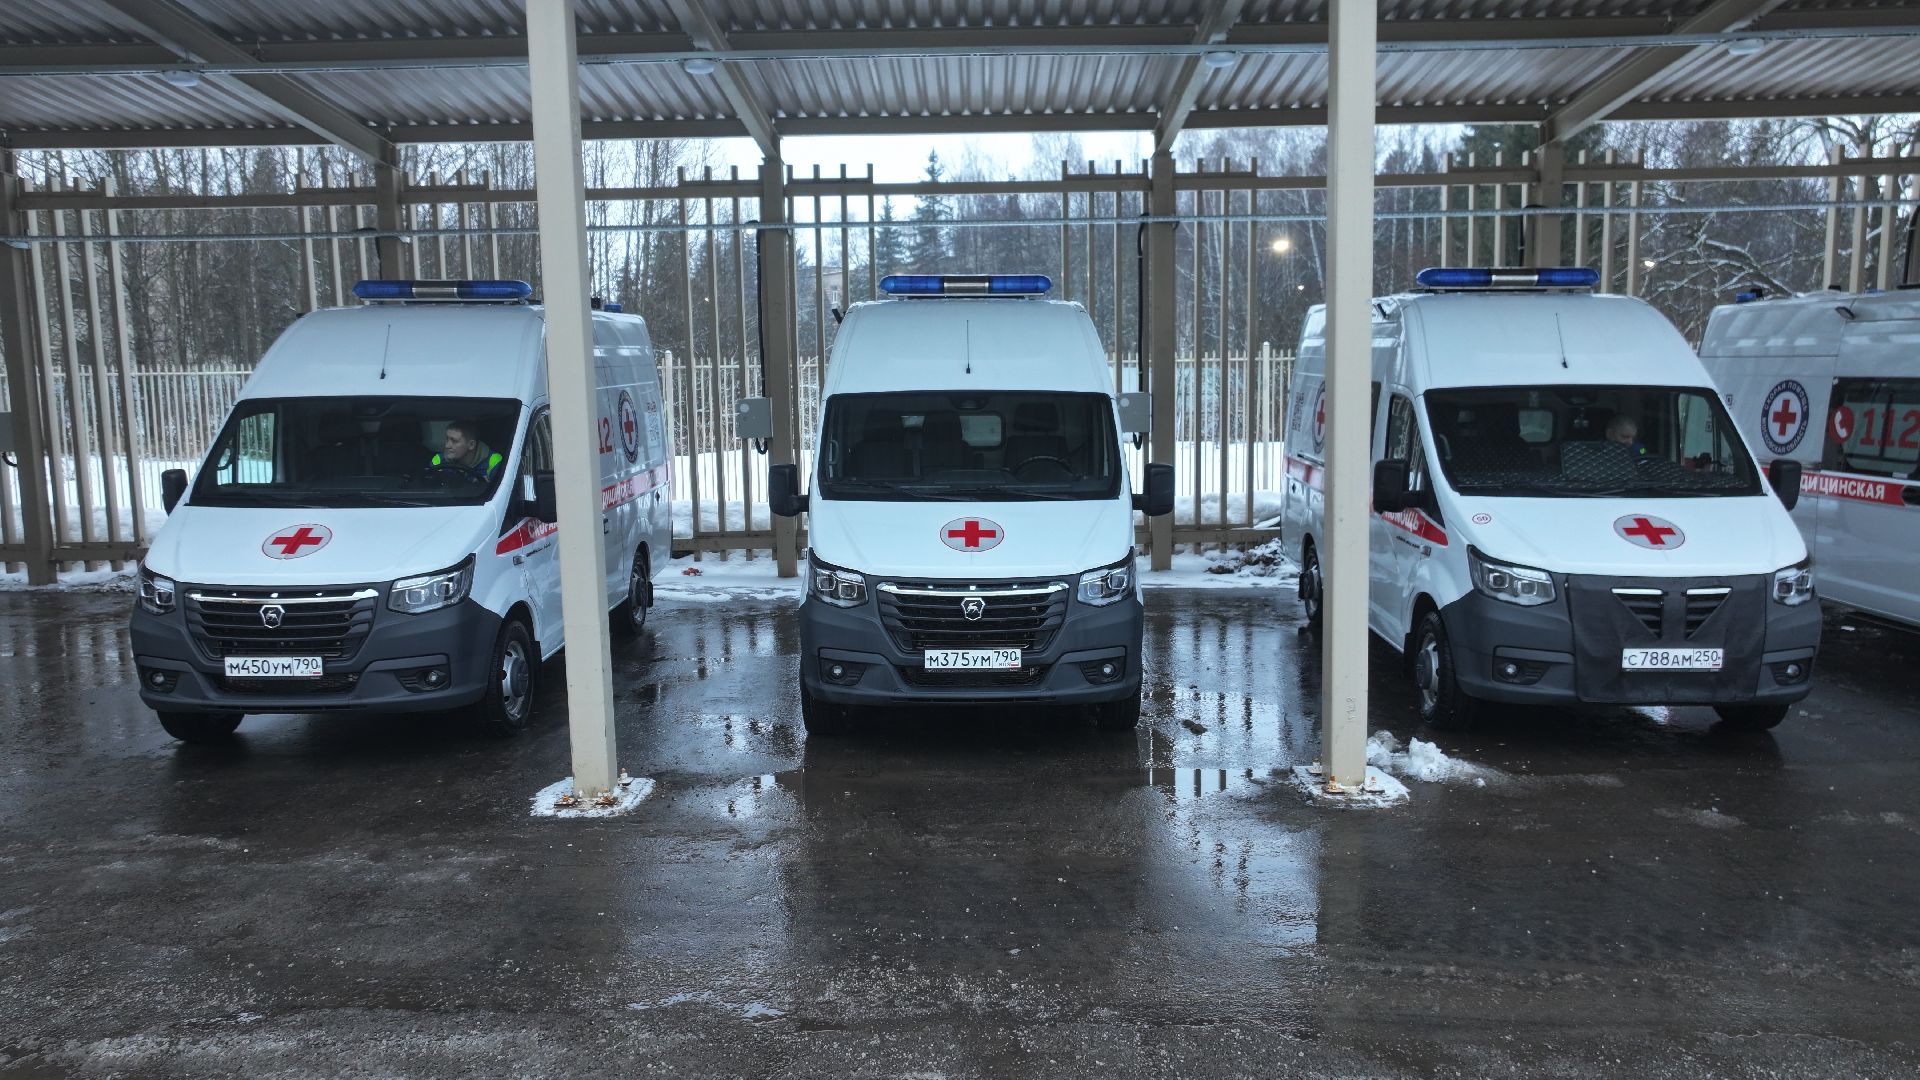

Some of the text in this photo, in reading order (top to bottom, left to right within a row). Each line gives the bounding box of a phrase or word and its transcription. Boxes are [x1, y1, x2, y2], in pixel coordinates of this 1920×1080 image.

[598, 417, 612, 454] 12
[1860, 408, 1920, 449] 112
[1800, 475, 1885, 500] ДИЦИНСКАЯ
[229, 658, 318, 674] М450УМ 790
[929, 650, 1017, 667] М375УМ 790
[1628, 650, 1718, 666] С788АМ 250
